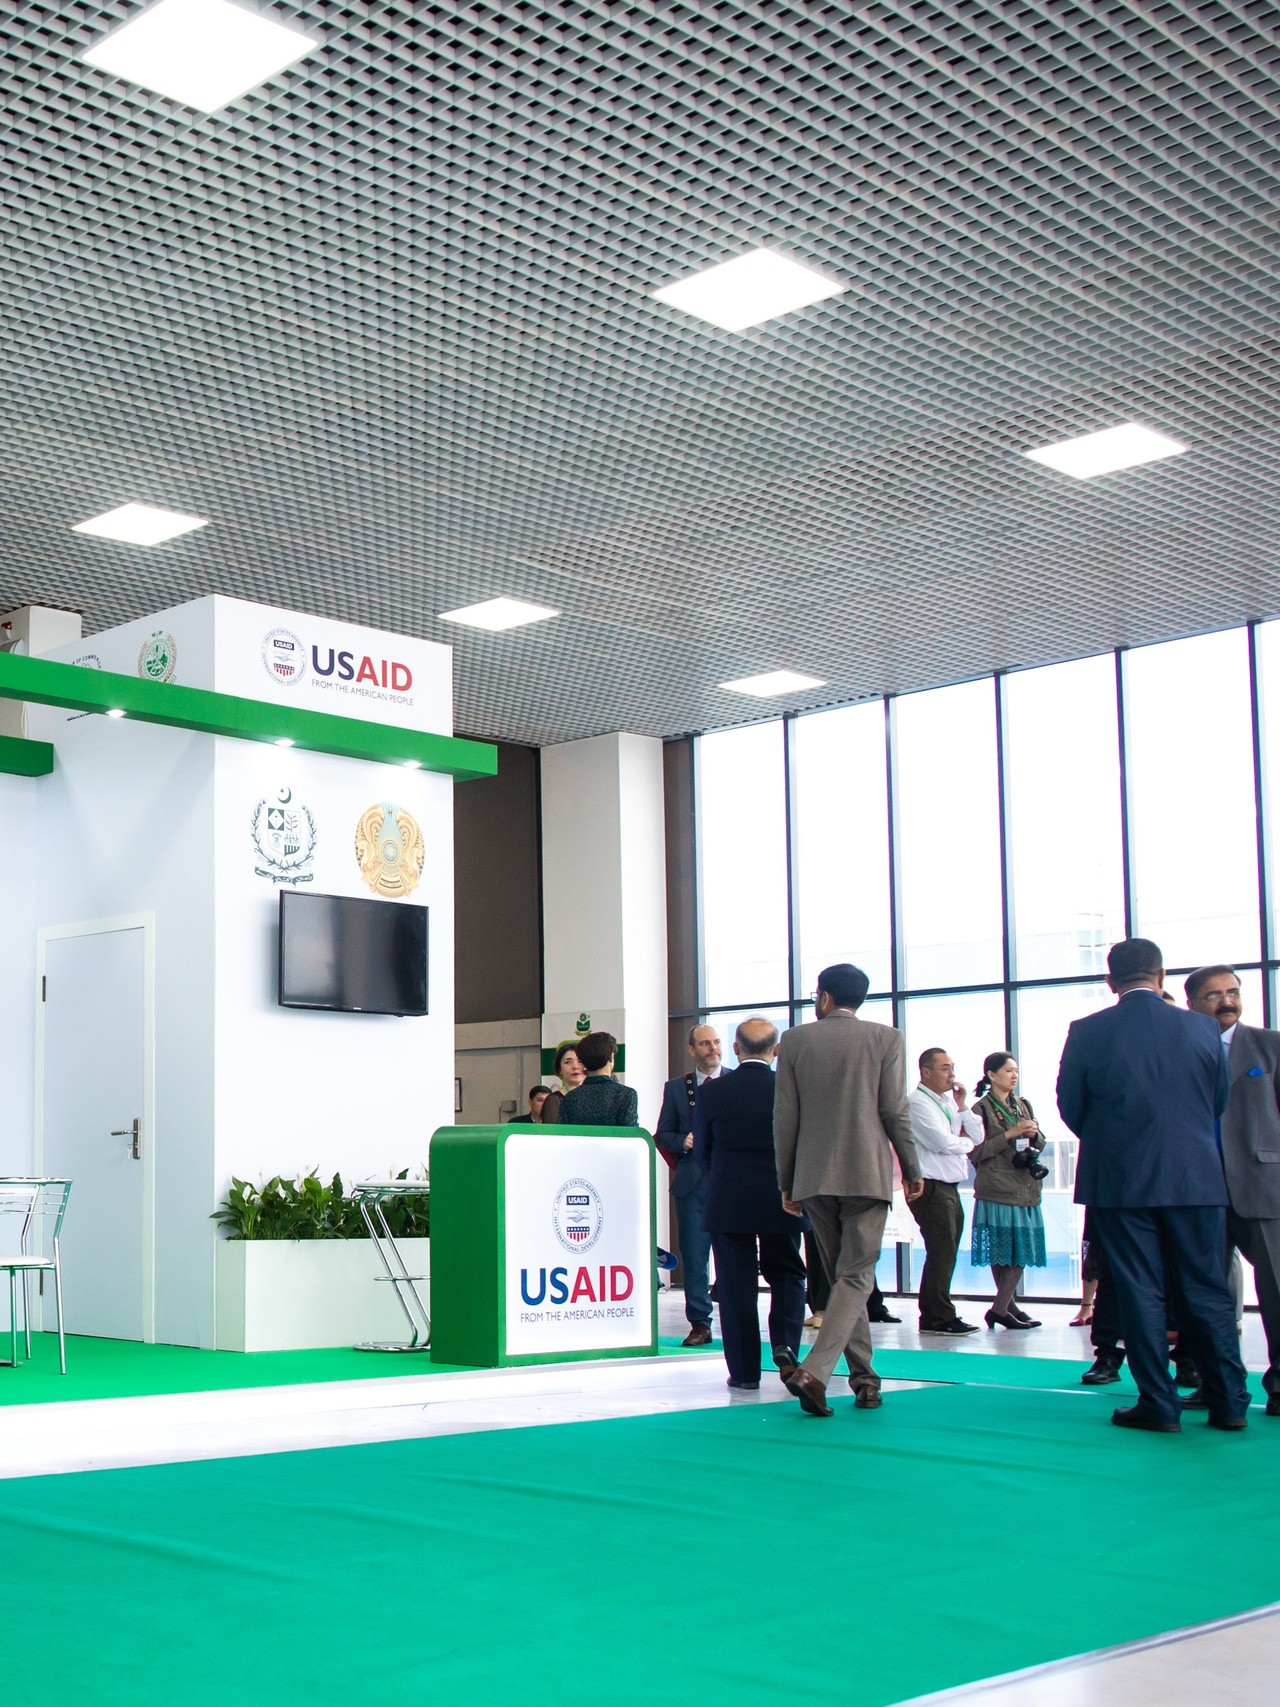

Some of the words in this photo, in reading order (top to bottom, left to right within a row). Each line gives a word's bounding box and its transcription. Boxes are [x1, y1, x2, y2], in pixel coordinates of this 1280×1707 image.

[312, 645, 412, 692] USAID
[312, 678, 333, 690] FROM
[335, 683, 349, 693] THE
[351, 686, 387, 701] AMERICAN
[389, 694, 414, 706] PEOPLE
[555, 1184, 569, 1204] UNITED
[568, 1196, 588, 1204] USAID
[521, 1265, 634, 1306] USAID
[520, 1312, 543, 1323] FROM
[545, 1311, 561, 1321] THE
[563, 1309, 604, 1321] AMERICAN
[607, 1307, 634, 1318] PEOPLE
